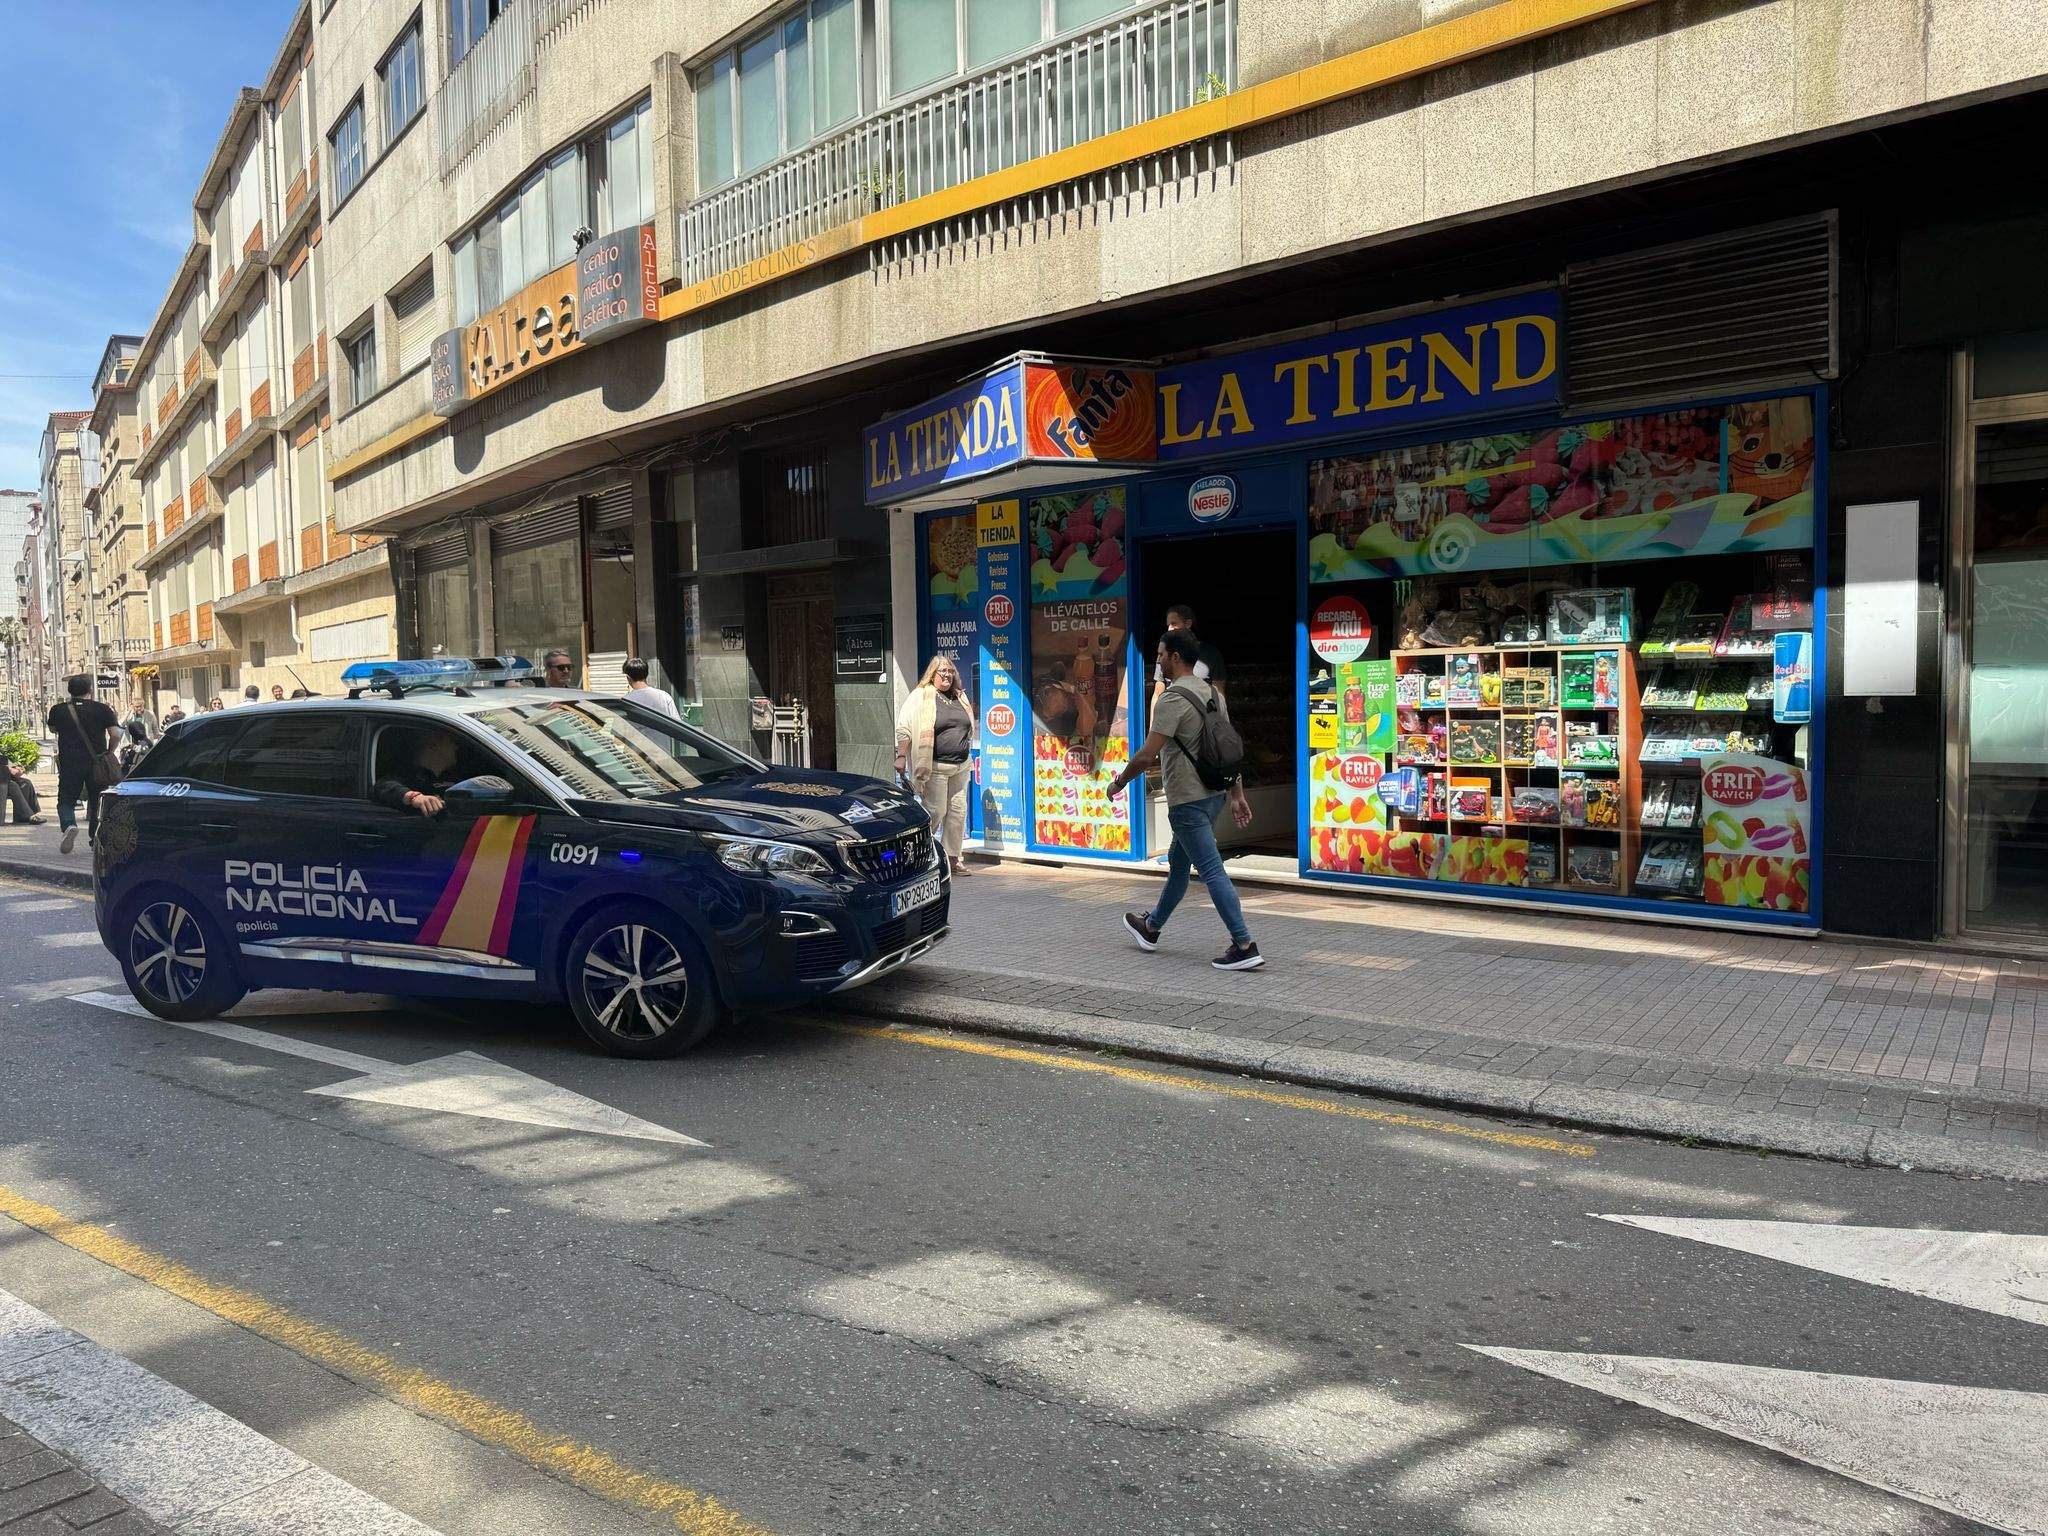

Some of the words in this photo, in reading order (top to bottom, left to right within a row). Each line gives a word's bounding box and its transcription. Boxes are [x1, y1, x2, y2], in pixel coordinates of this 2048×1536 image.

[583, 245, 619, 275] centro
[711, 239, 816, 298] MODELCLINICS
[643, 233, 657, 313] Altea
[583, 271, 622, 301] médico
[582, 297, 628, 331] estético
[477, 292, 580, 386] Altea
[1046, 368, 1135, 458] Fanta
[1158, 372, 1254, 446] LA
[869, 431, 902, 489] LA
[905, 384, 1018, 478] TIENDA
[1196, 479, 1227, 491] HELADOS
[1193, 493, 1230, 511] Nestlé
[991, 505, 1004, 520] LA
[980, 526, 1016, 544] TIENDA
[989, 601, 1010, 614] FRIT
[1043, 601, 1118, 618] LLÉVATELOS
[1317, 610, 1357, 622] RECARGA
[936, 621, 960, 634] AAALAS
[960, 620, 977, 633] PARA
[1051, 620, 1067, 632] DE
[1070, 618, 1110, 631] CALLE
[851, 638, 873, 649] Altea
[936, 636, 957, 648] TODOS
[957, 635, 969, 647] TUS
[1774, 664, 1793, 676] Red
[1366, 681, 1390, 692] fuze
[1368, 691, 1385, 699] tea
[990, 711, 1011, 723] FRIT
[1067, 751, 1091, 764] FRIT
[1345, 761, 1377, 775] FRIT
[1711, 772, 1756, 790] FRIT
[559, 843, 599, 866] 091
[225, 859, 369, 894] POLICÍA
[226, 886, 418, 926] NACIONAL
